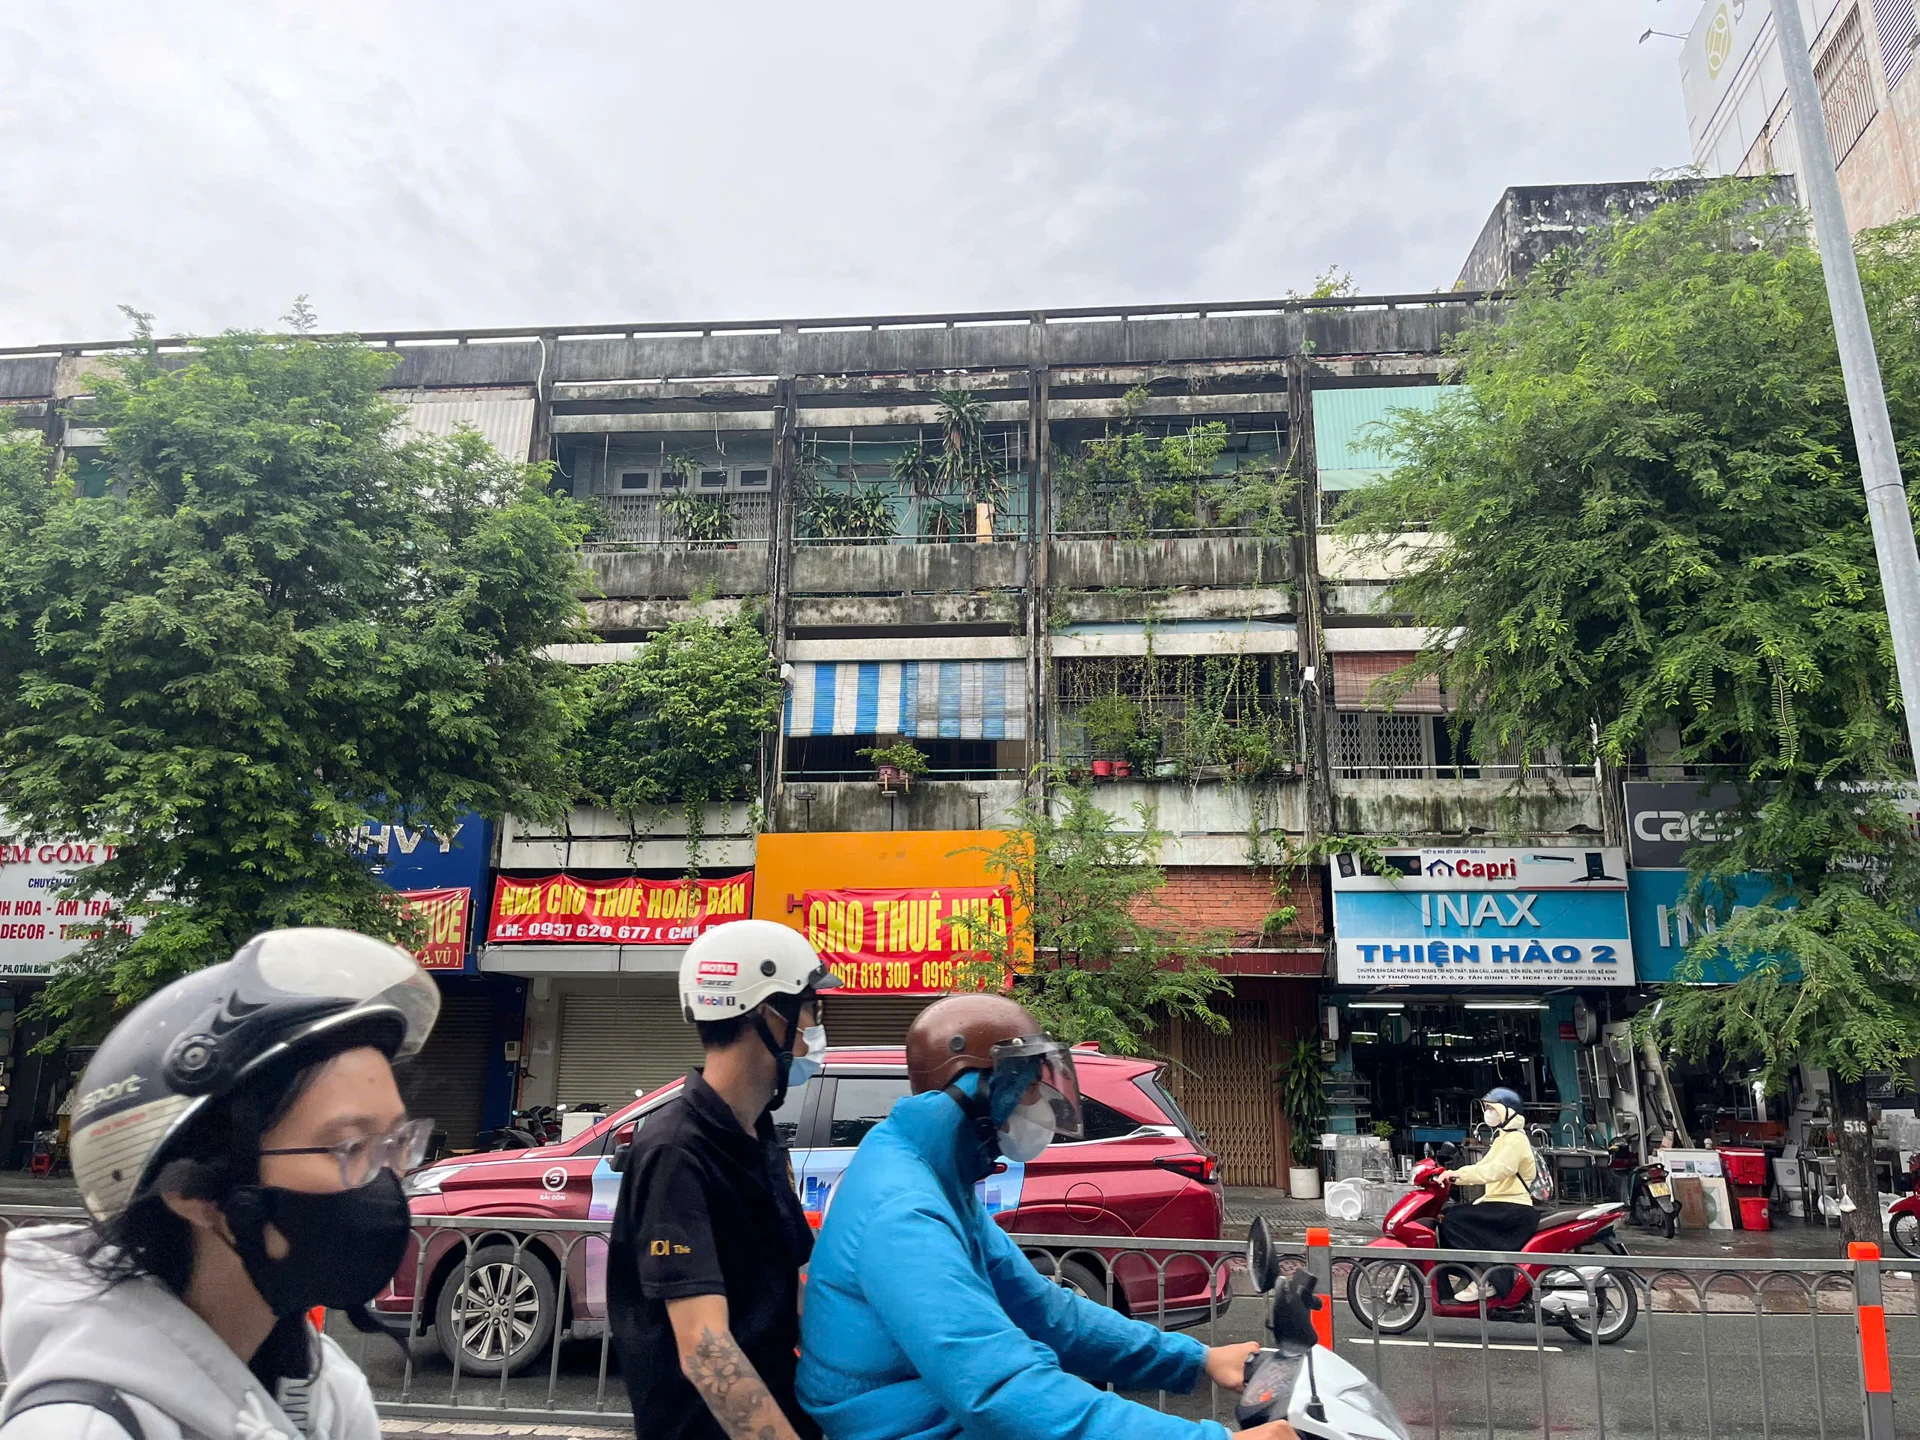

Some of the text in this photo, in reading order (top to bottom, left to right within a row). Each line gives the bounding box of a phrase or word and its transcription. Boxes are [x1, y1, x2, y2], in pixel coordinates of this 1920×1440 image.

[38, 841, 97, 864] GỐM
[1456, 858, 1517, 881] Capri
[15, 901, 41, 915] HOA
[500, 883, 542, 916] NHÀ
[546, 884, 587, 916] CHO
[592, 885, 643, 917] THUÊ
[705, 882, 745, 915] BÁN
[1421, 894, 1540, 926] INAX
[1, 924, 45, 939] DECOR
[496, 924, 523, 937] LH:
[528, 922, 574, 937] 0937
[576, 924, 612, 938] 620
[617, 925, 651, 939] 677
[808, 900, 864, 954] CHO
[873, 891, 943, 953] THUÊ
[1356, 940, 1480, 967] THIỆN
[1592, 946, 1617, 963] 2
[860, 962, 882, 988] 813
[886, 962, 910, 988] 300
[922, 961, 952, 988] 0913
[1844, 1121, 1867, 1132] 516
